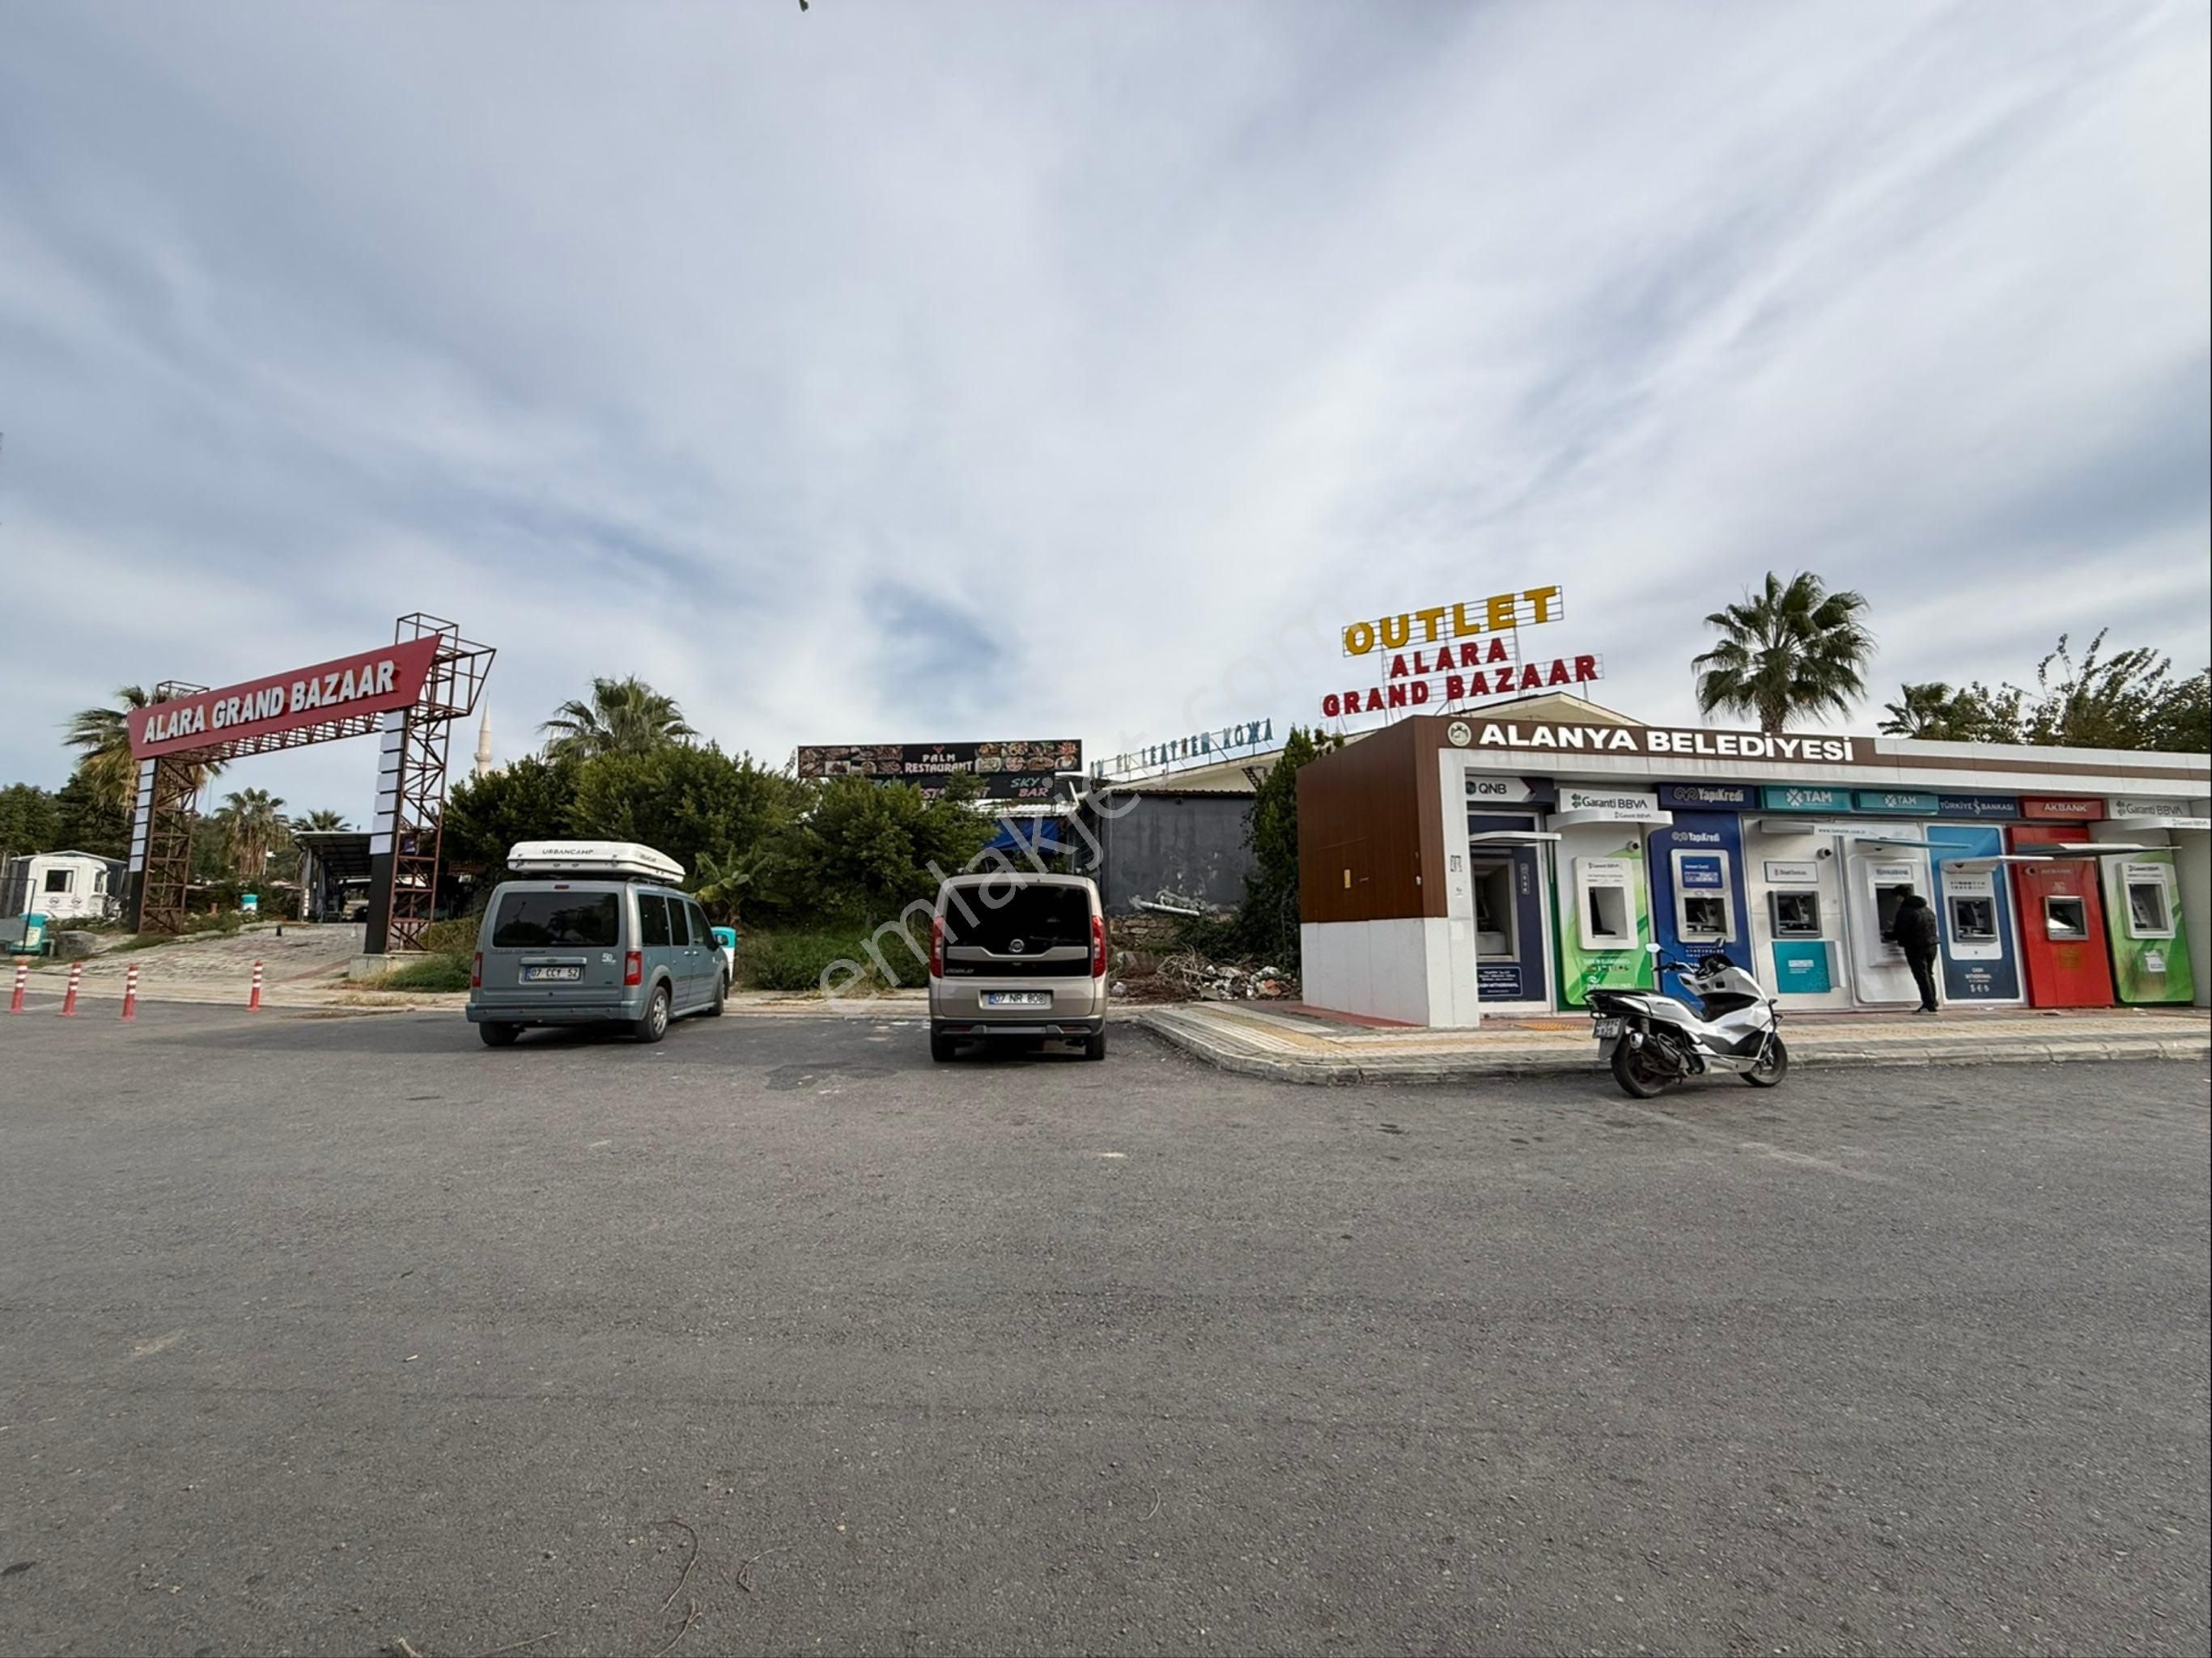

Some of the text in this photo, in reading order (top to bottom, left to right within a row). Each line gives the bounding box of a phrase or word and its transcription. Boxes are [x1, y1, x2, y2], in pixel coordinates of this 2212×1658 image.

[1344, 586, 1556, 655] OUTLET
[1390, 638, 1508, 679] ALARA
[1323, 655, 1598, 717] GRAND BAZAAR
[142, 660, 395, 744] ALARA GRAND BAZAAR
[1479, 724, 1853, 761] ALANYA BELEDİYESİ
[922, 753, 956, 762] PALM
[905, 761, 973, 773] RESTAURANT
[1011, 778, 1039, 787] SKY
[1479, 782, 1507, 794] QNB
[1018, 787, 1049, 797] BAR
[1803, 791, 1833, 803] TAM
[1582, 795, 1648, 809] Garanti BBVA
[1897, 796, 1917, 805] TAM
[2044, 803, 2087, 812] AKBANK
[2126, 804, 2183, 815] Garanti BBVA
[996, 993, 1005, 1003] 07
[1010, 993, 1023, 1003] NR
